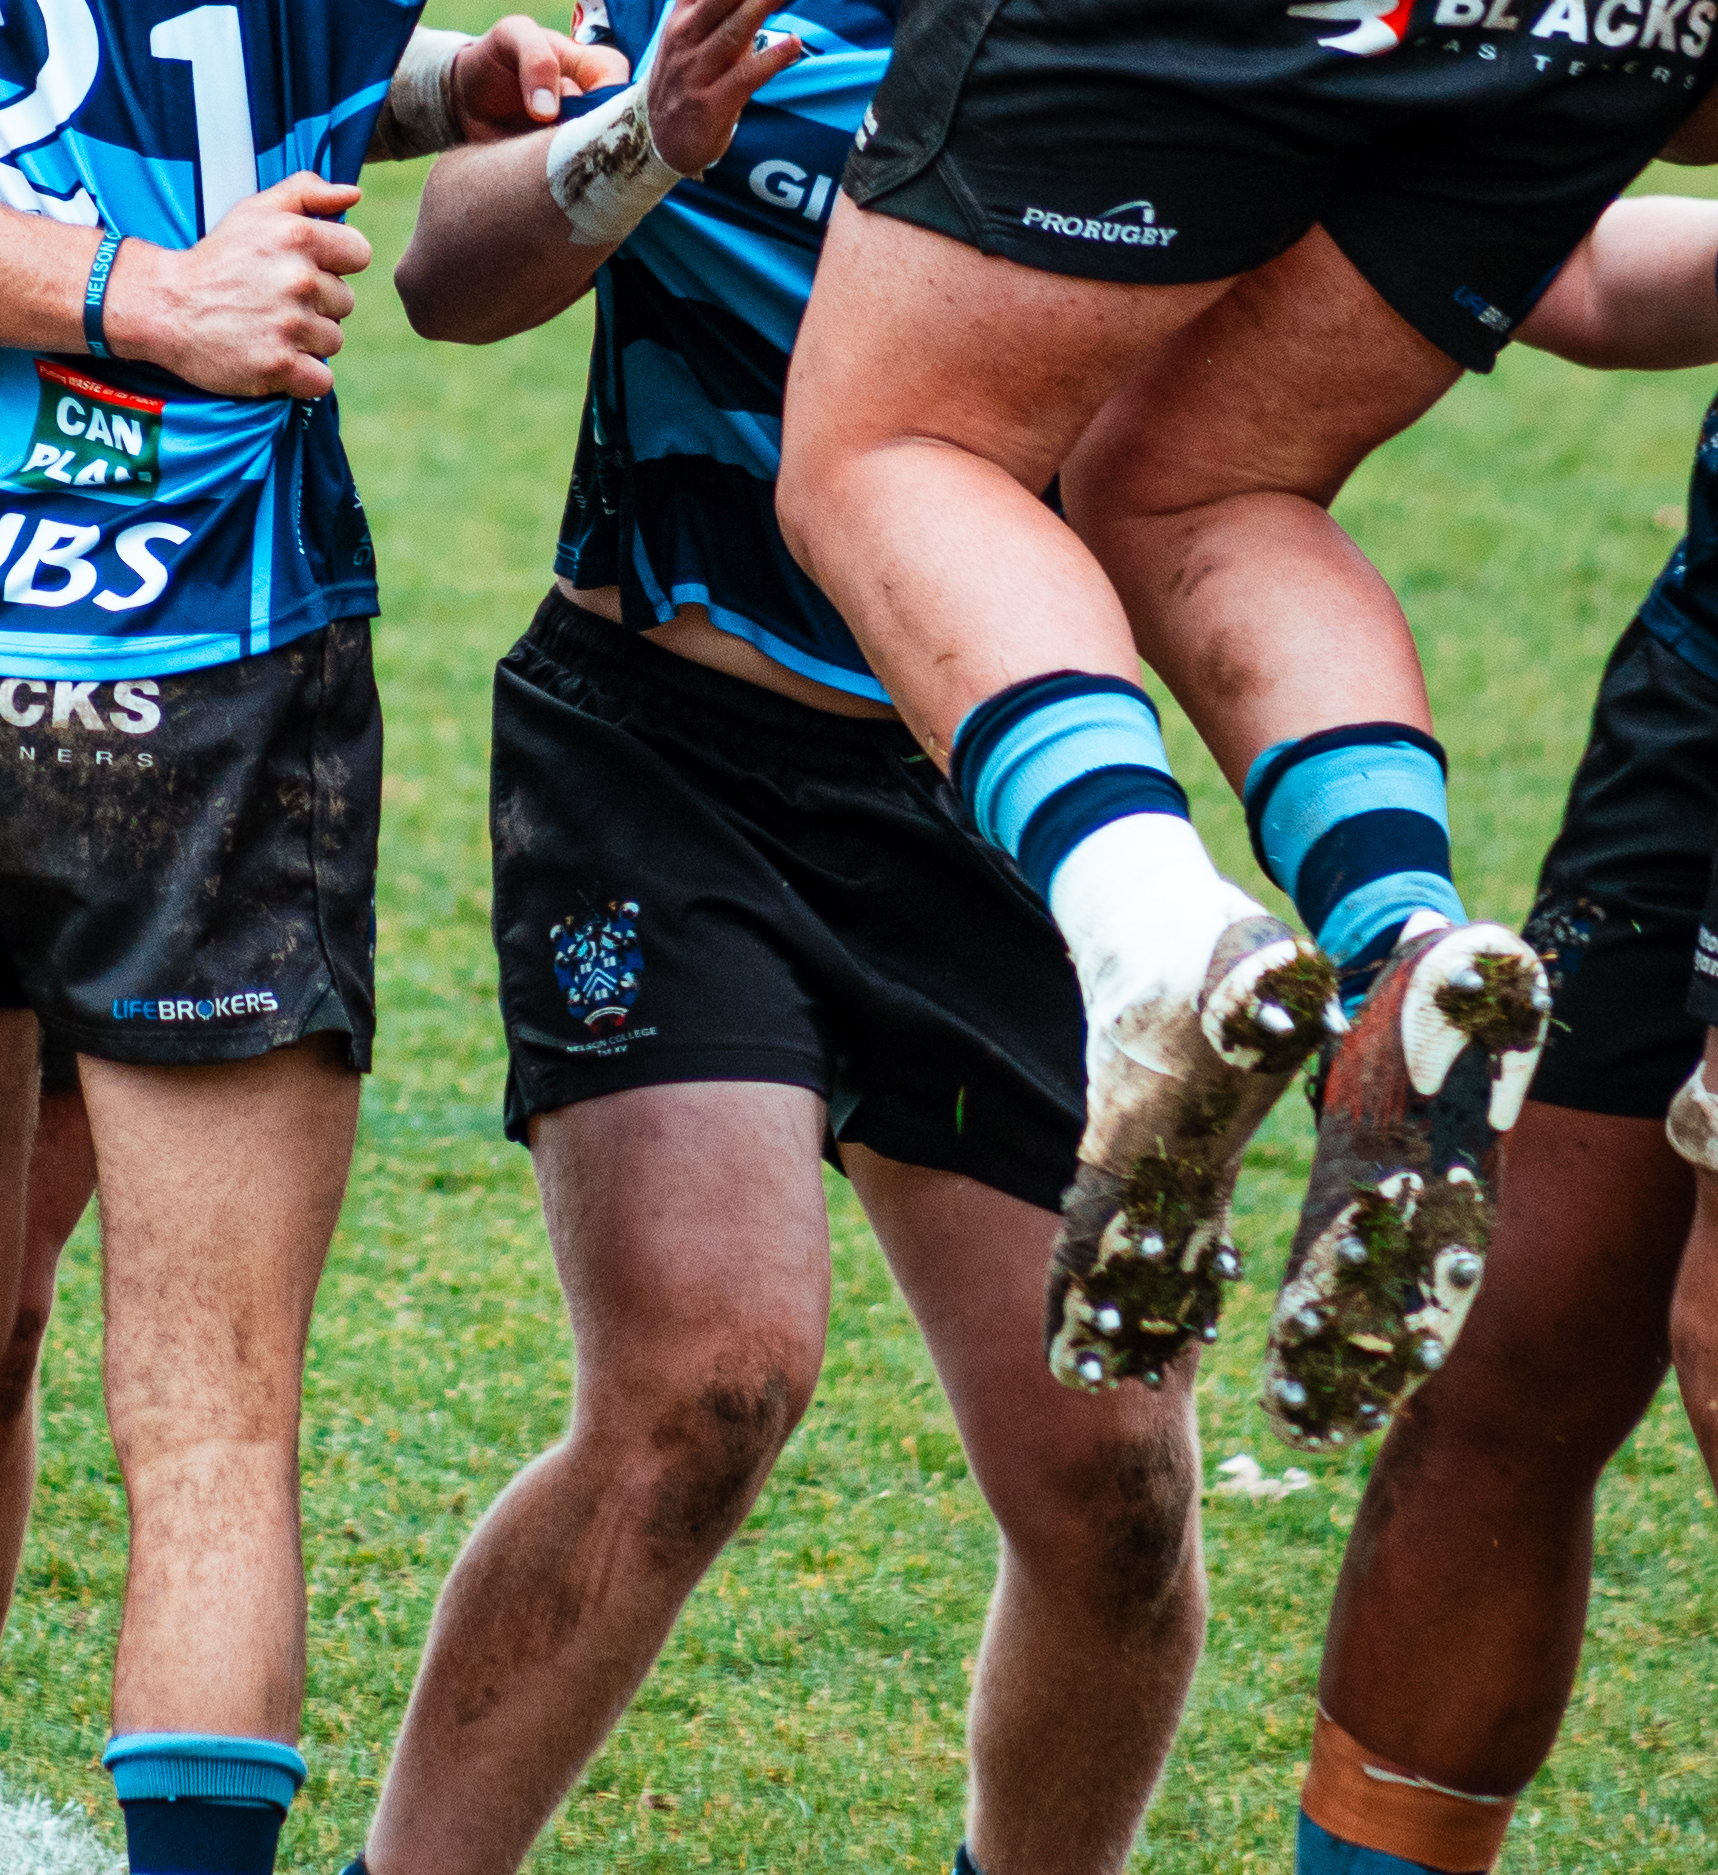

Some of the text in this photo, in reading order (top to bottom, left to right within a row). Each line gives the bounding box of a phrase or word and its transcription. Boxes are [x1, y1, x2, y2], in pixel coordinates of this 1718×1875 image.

[1021, 206, 1180, 247] PRORUGBY
[85, 241, 119, 306] NELSON
[56, 395, 143, 457] CAN
[110, 991, 280, 1021] LIFEBROKERS
